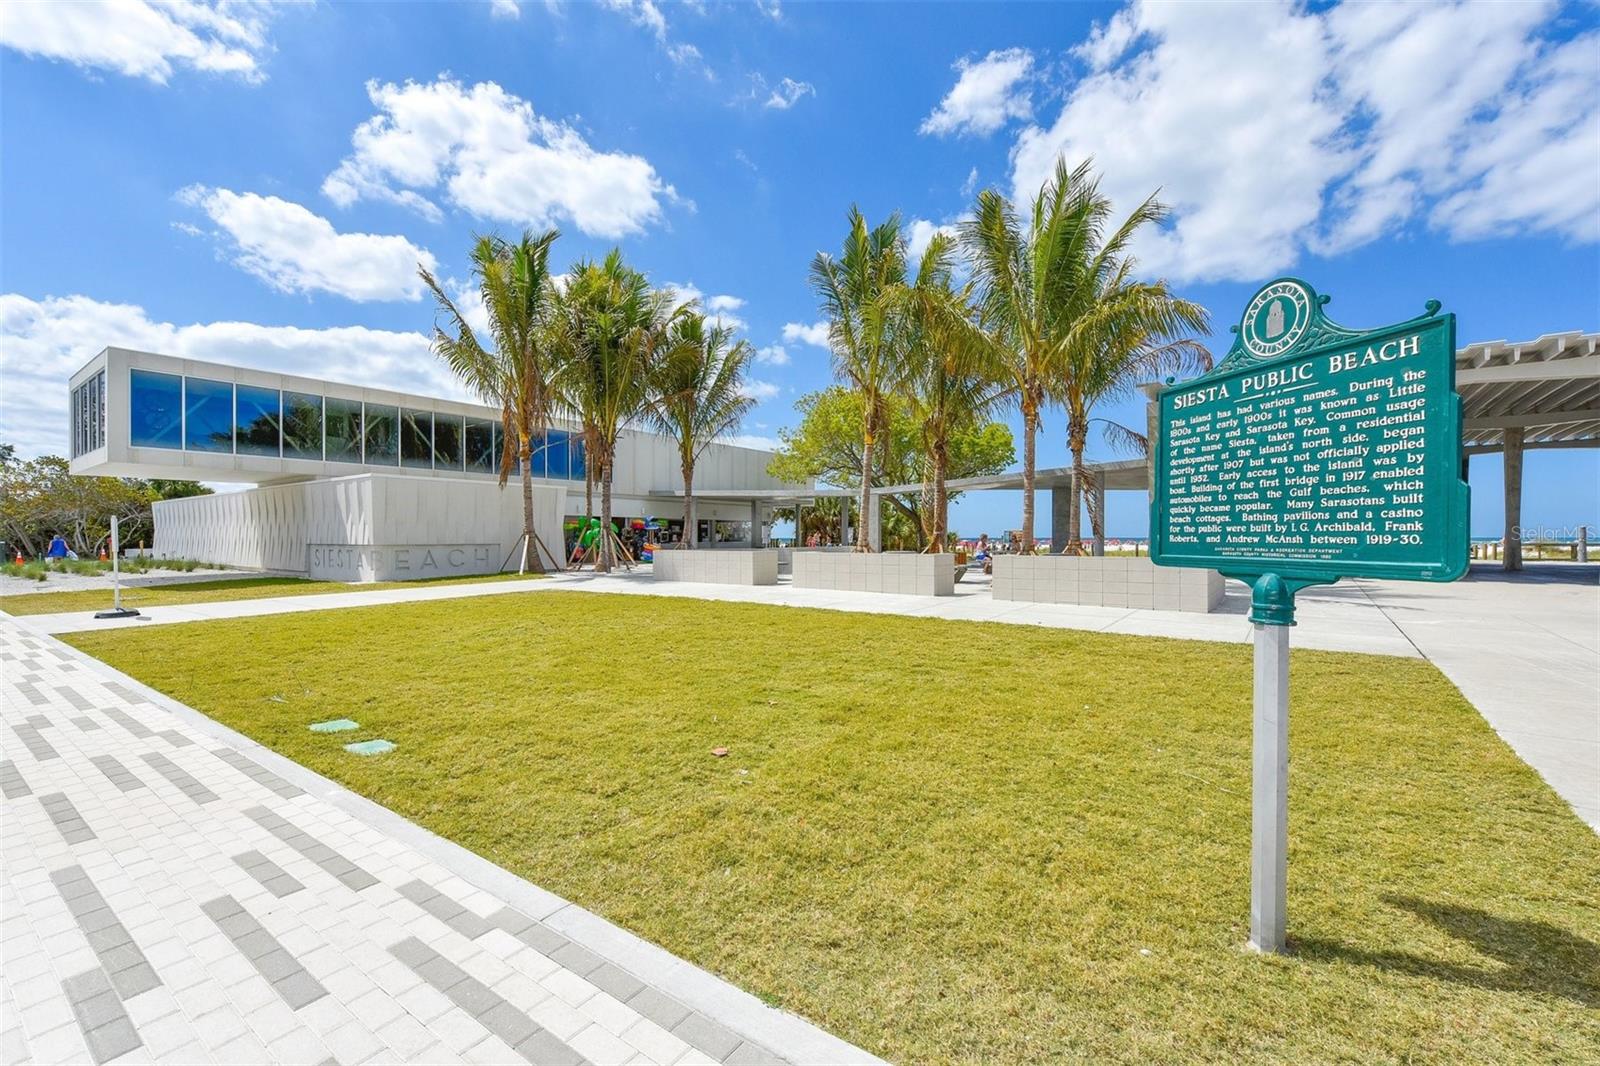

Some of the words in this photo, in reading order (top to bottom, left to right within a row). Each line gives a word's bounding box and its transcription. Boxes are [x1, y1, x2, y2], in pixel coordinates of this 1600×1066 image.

[1246, 285, 1306, 326] SARASOTA
[1250, 325, 1301, 353] COUNTY
[1174, 384, 1229, 409] SIESTA
[1242, 363, 1313, 393] PUBLIC
[1329, 336, 1419, 373] BEACH
[1171, 420, 1185, 428] This
[1190, 413, 1211, 424] island
[1217, 410, 1231, 419] has
[1237, 405, 1252, 415] had
[1260, 396, 1295, 409] various
[1350, 377, 1393, 392] During
[1403, 370, 1426, 381] the
[1171, 428, 1191, 437] 1800s
[1196, 424, 1209, 432] and
[1217, 419, 1238, 428] early
[1245, 412, 1272, 424] 1900s
[1279, 409, 1286, 417] it
[1294, 406, 1312, 414] was
[1320, 397, 1357, 410] known
[1366, 393, 1379, 402] as
[1389, 384, 1425, 397] Little
[1170, 437, 1200, 447] Sarasota
[1205, 433, 1220, 441] Key
[1225, 429, 1240, 438] and
[1247, 421, 1287, 434] Sarasota
[1326, 407, 1376, 420] Common
[1386, 398, 1425, 411] usage
[1202, 443, 1222, 452] name
[1268, 432, 1294, 442] taken
[1303, 426, 1329, 437] from
[1356, 411, 1425, 429] residential
[1170, 454, 1214, 466] development
[1237, 449, 1251, 457] the
[1260, 441, 1293, 454] island's
[1302, 438, 1332, 449] north
[1384, 426, 1424, 438] began
[1170, 467, 1195, 476] shortly
[1199, 464, 1219, 472] after
[1224, 460, 1244, 470] 1907
[1250, 458, 1264, 466] but
[1271, 456, 1287, 464] was
[1294, 452, 1310, 461] not
[1317, 445, 1369, 459] officially
[1376, 439, 1424, 453] applied
[1170, 477, 1185, 485] until
[1219, 472, 1240, 480] Early
[1247, 468, 1276, 478] access
[1285, 466, 1295, 474] to
[1303, 463, 1320, 472] the
[1328, 459, 1363, 470] island
[1373, 457, 1397, 466] was
[1407, 453, 1424, 463] by
[1191, 485, 1222, 493] Building
[1227, 482, 1235, 490] of
[1240, 481, 1254, 489] the
[1260, 478, 1279, 487] first
[1285, 476, 1319, 486] bridge
[1326, 474, 1335, 482] in
[1342, 471, 1365, 481] 1917
[1373, 466, 1424, 478] enabled
[1170, 495, 1212, 504] automobiles
[1219, 493, 1227, 501] to
[1234, 492, 1259, 500] reach
[1267, 489, 1282, 498] the
[1290, 487, 1311, 497] Gulf
[1384, 480, 1424, 491] which
[1170, 506, 1196, 514] quickly
[1200, 504, 1230, 512] became
[1287, 500, 1314, 509] Many
[1321, 497, 1385, 507] Sarasotans
[1393, 494, 1423, 504] built
[1199, 525, 1222, 533] public
[1275, 524, 1287, 533] by
[1385, 522, 1423, 531] Frank
[1243, 513, 1278, 522] Bathing
[1284, 511, 1329, 522] pavilions
[1337, 510, 1358, 519] and
[1381, 508, 1423, 518] casino
[1226, 535, 1259, 543] Andrew
[1311, 535, 1357, 544] between
[314, 548, 365, 570] SIESTA
[371, 548, 489, 570] BEACH
